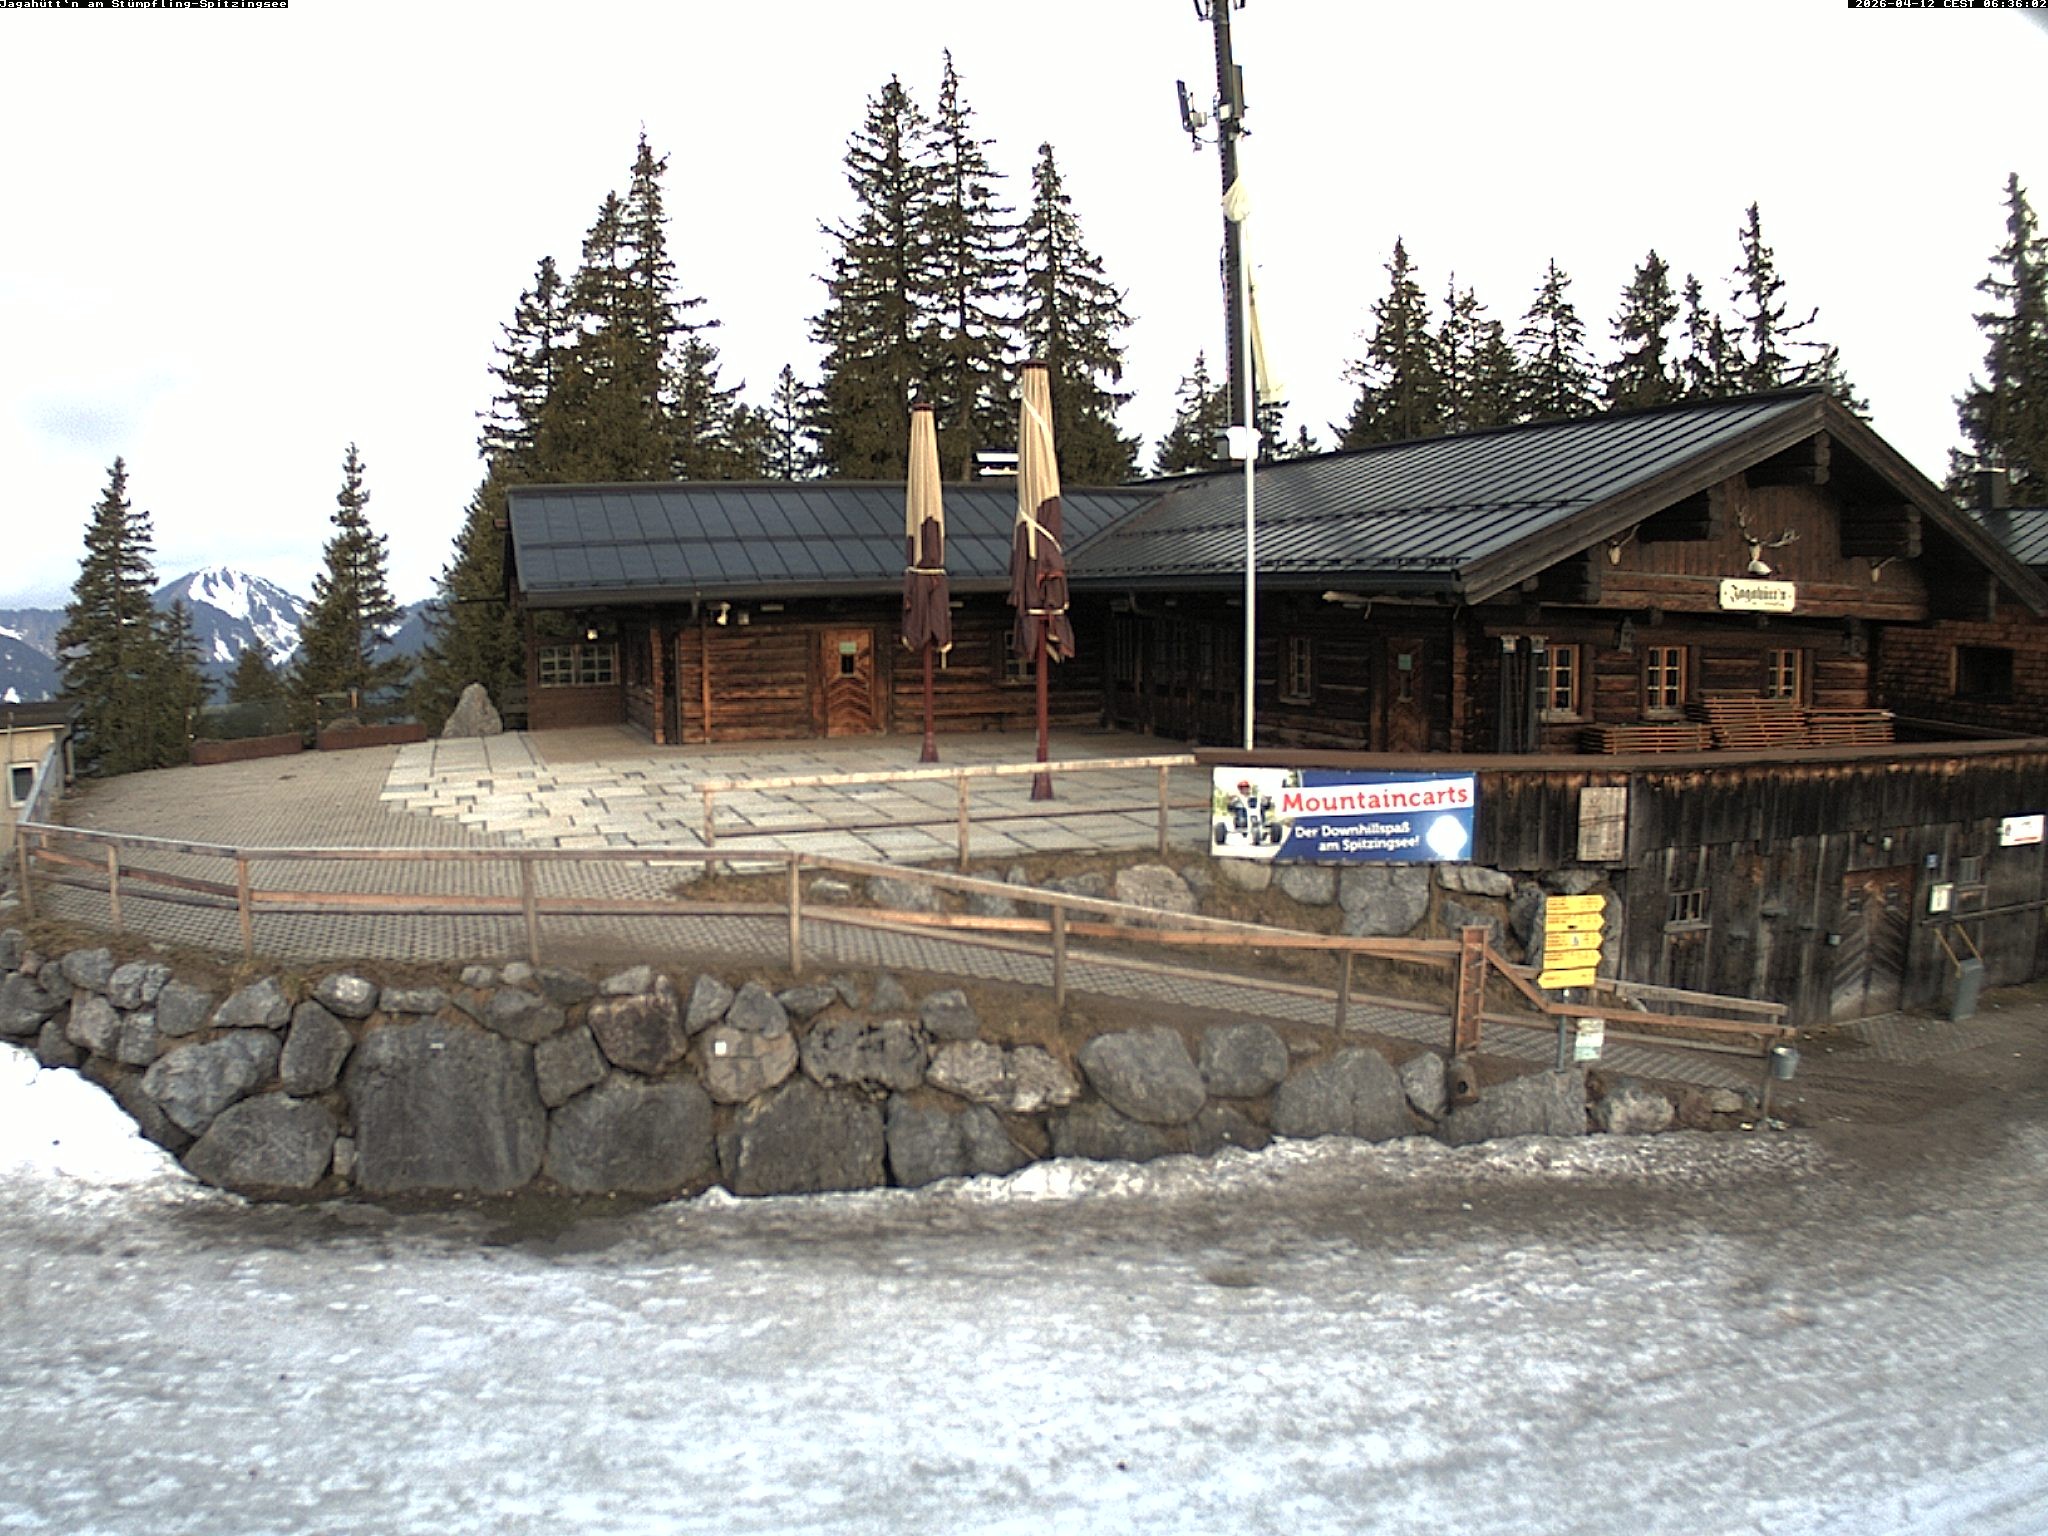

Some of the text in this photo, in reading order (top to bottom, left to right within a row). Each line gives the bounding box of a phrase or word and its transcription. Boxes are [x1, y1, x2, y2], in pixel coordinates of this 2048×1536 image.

[1282, 786, 1468, 813] Mountaincarts
[1295, 821, 1411, 838] Der Downhillspaß
[1318, 835, 1420, 852] am Spitzingsee!
